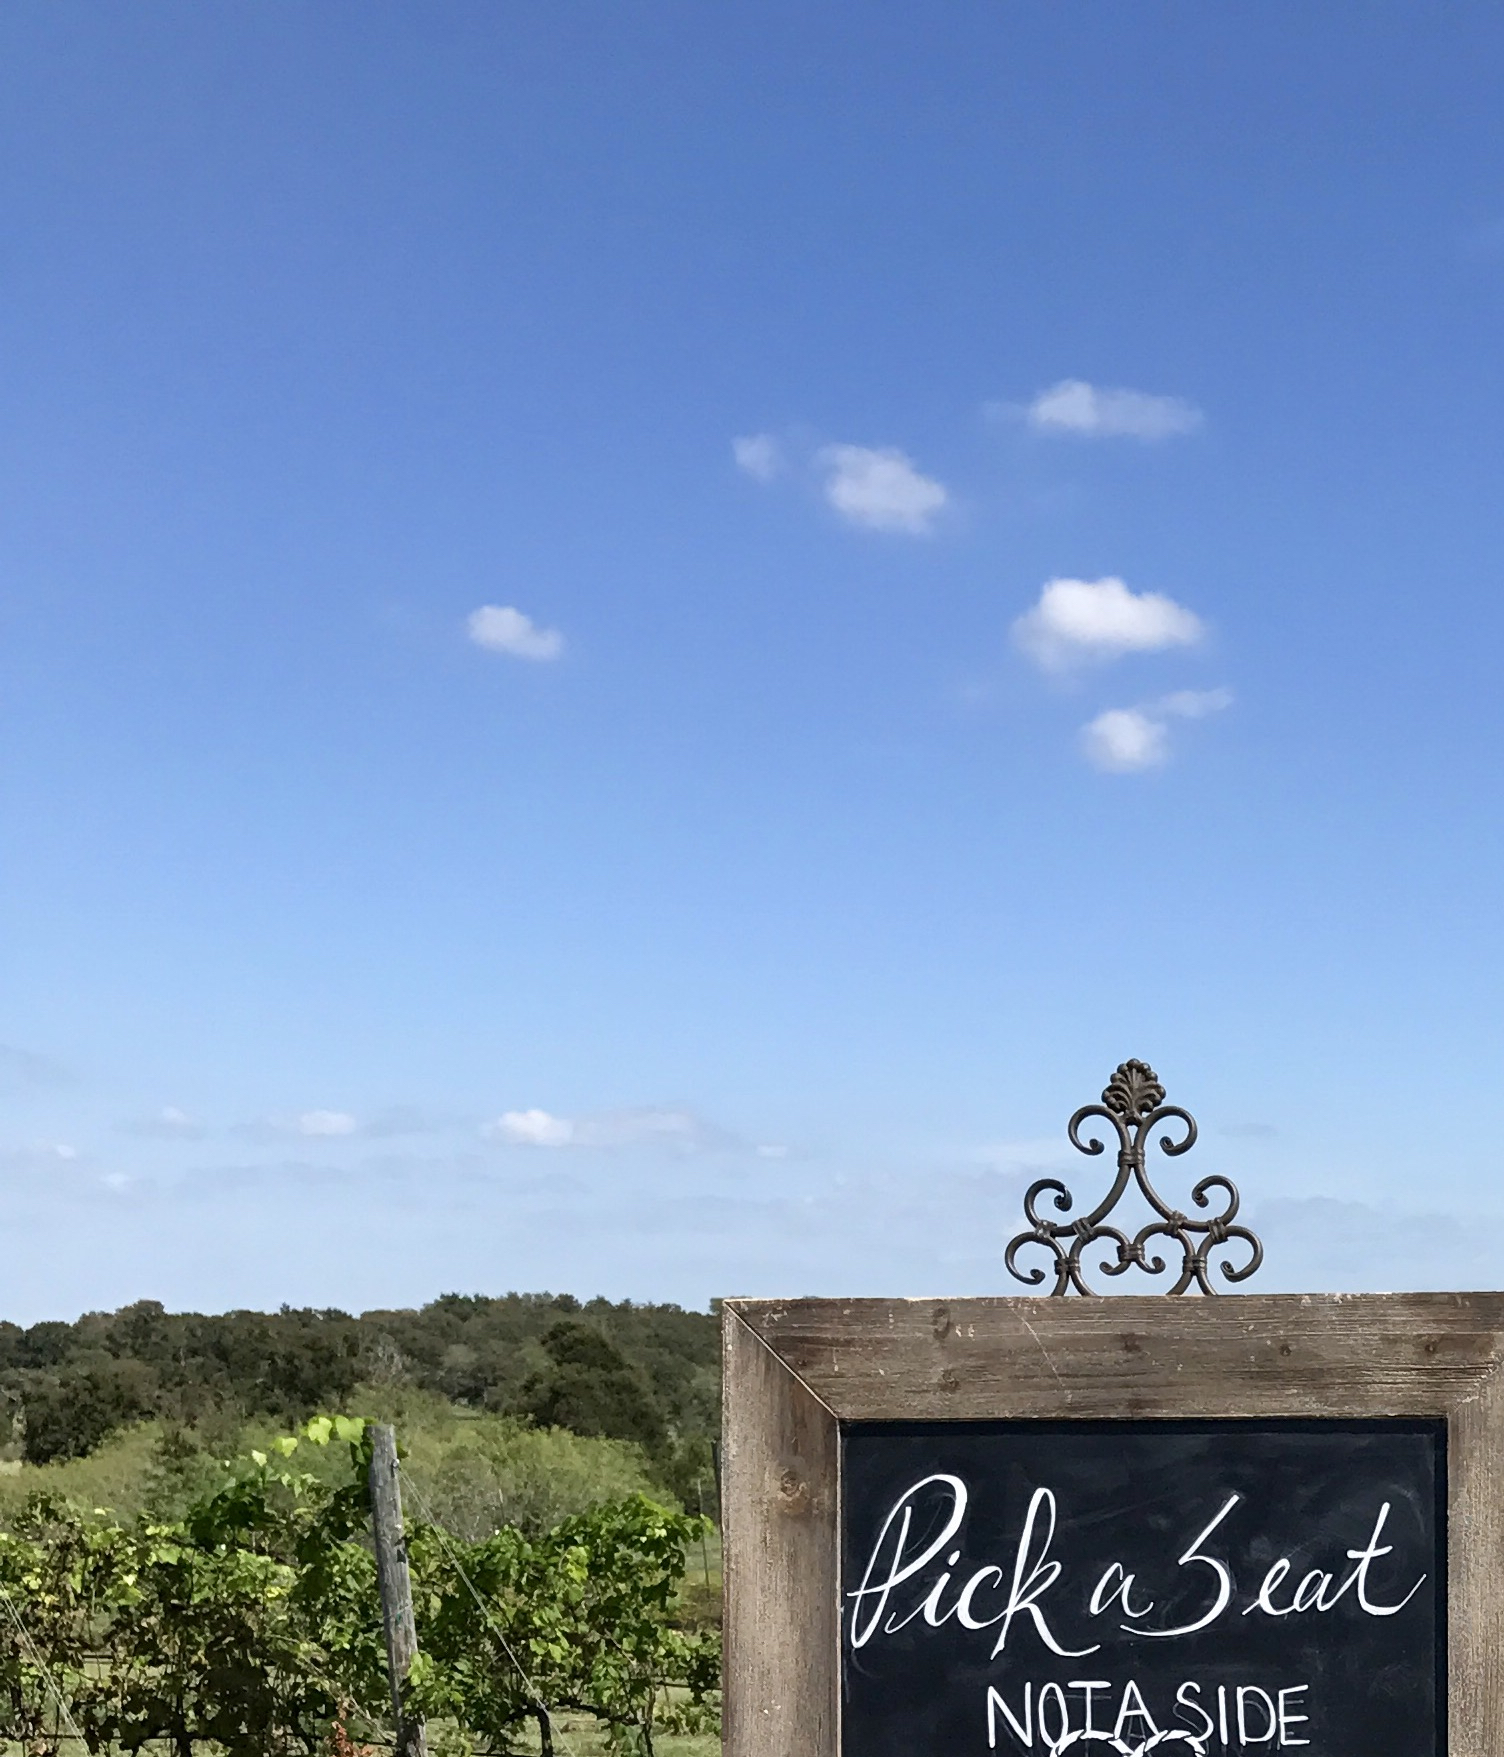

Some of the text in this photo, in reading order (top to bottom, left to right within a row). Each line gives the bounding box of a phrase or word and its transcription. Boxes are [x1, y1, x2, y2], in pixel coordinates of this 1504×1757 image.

[846, 1474, 1427, 1660] Pick a Seat
[987, 1680, 1311, 1749] NOT A SIDE
